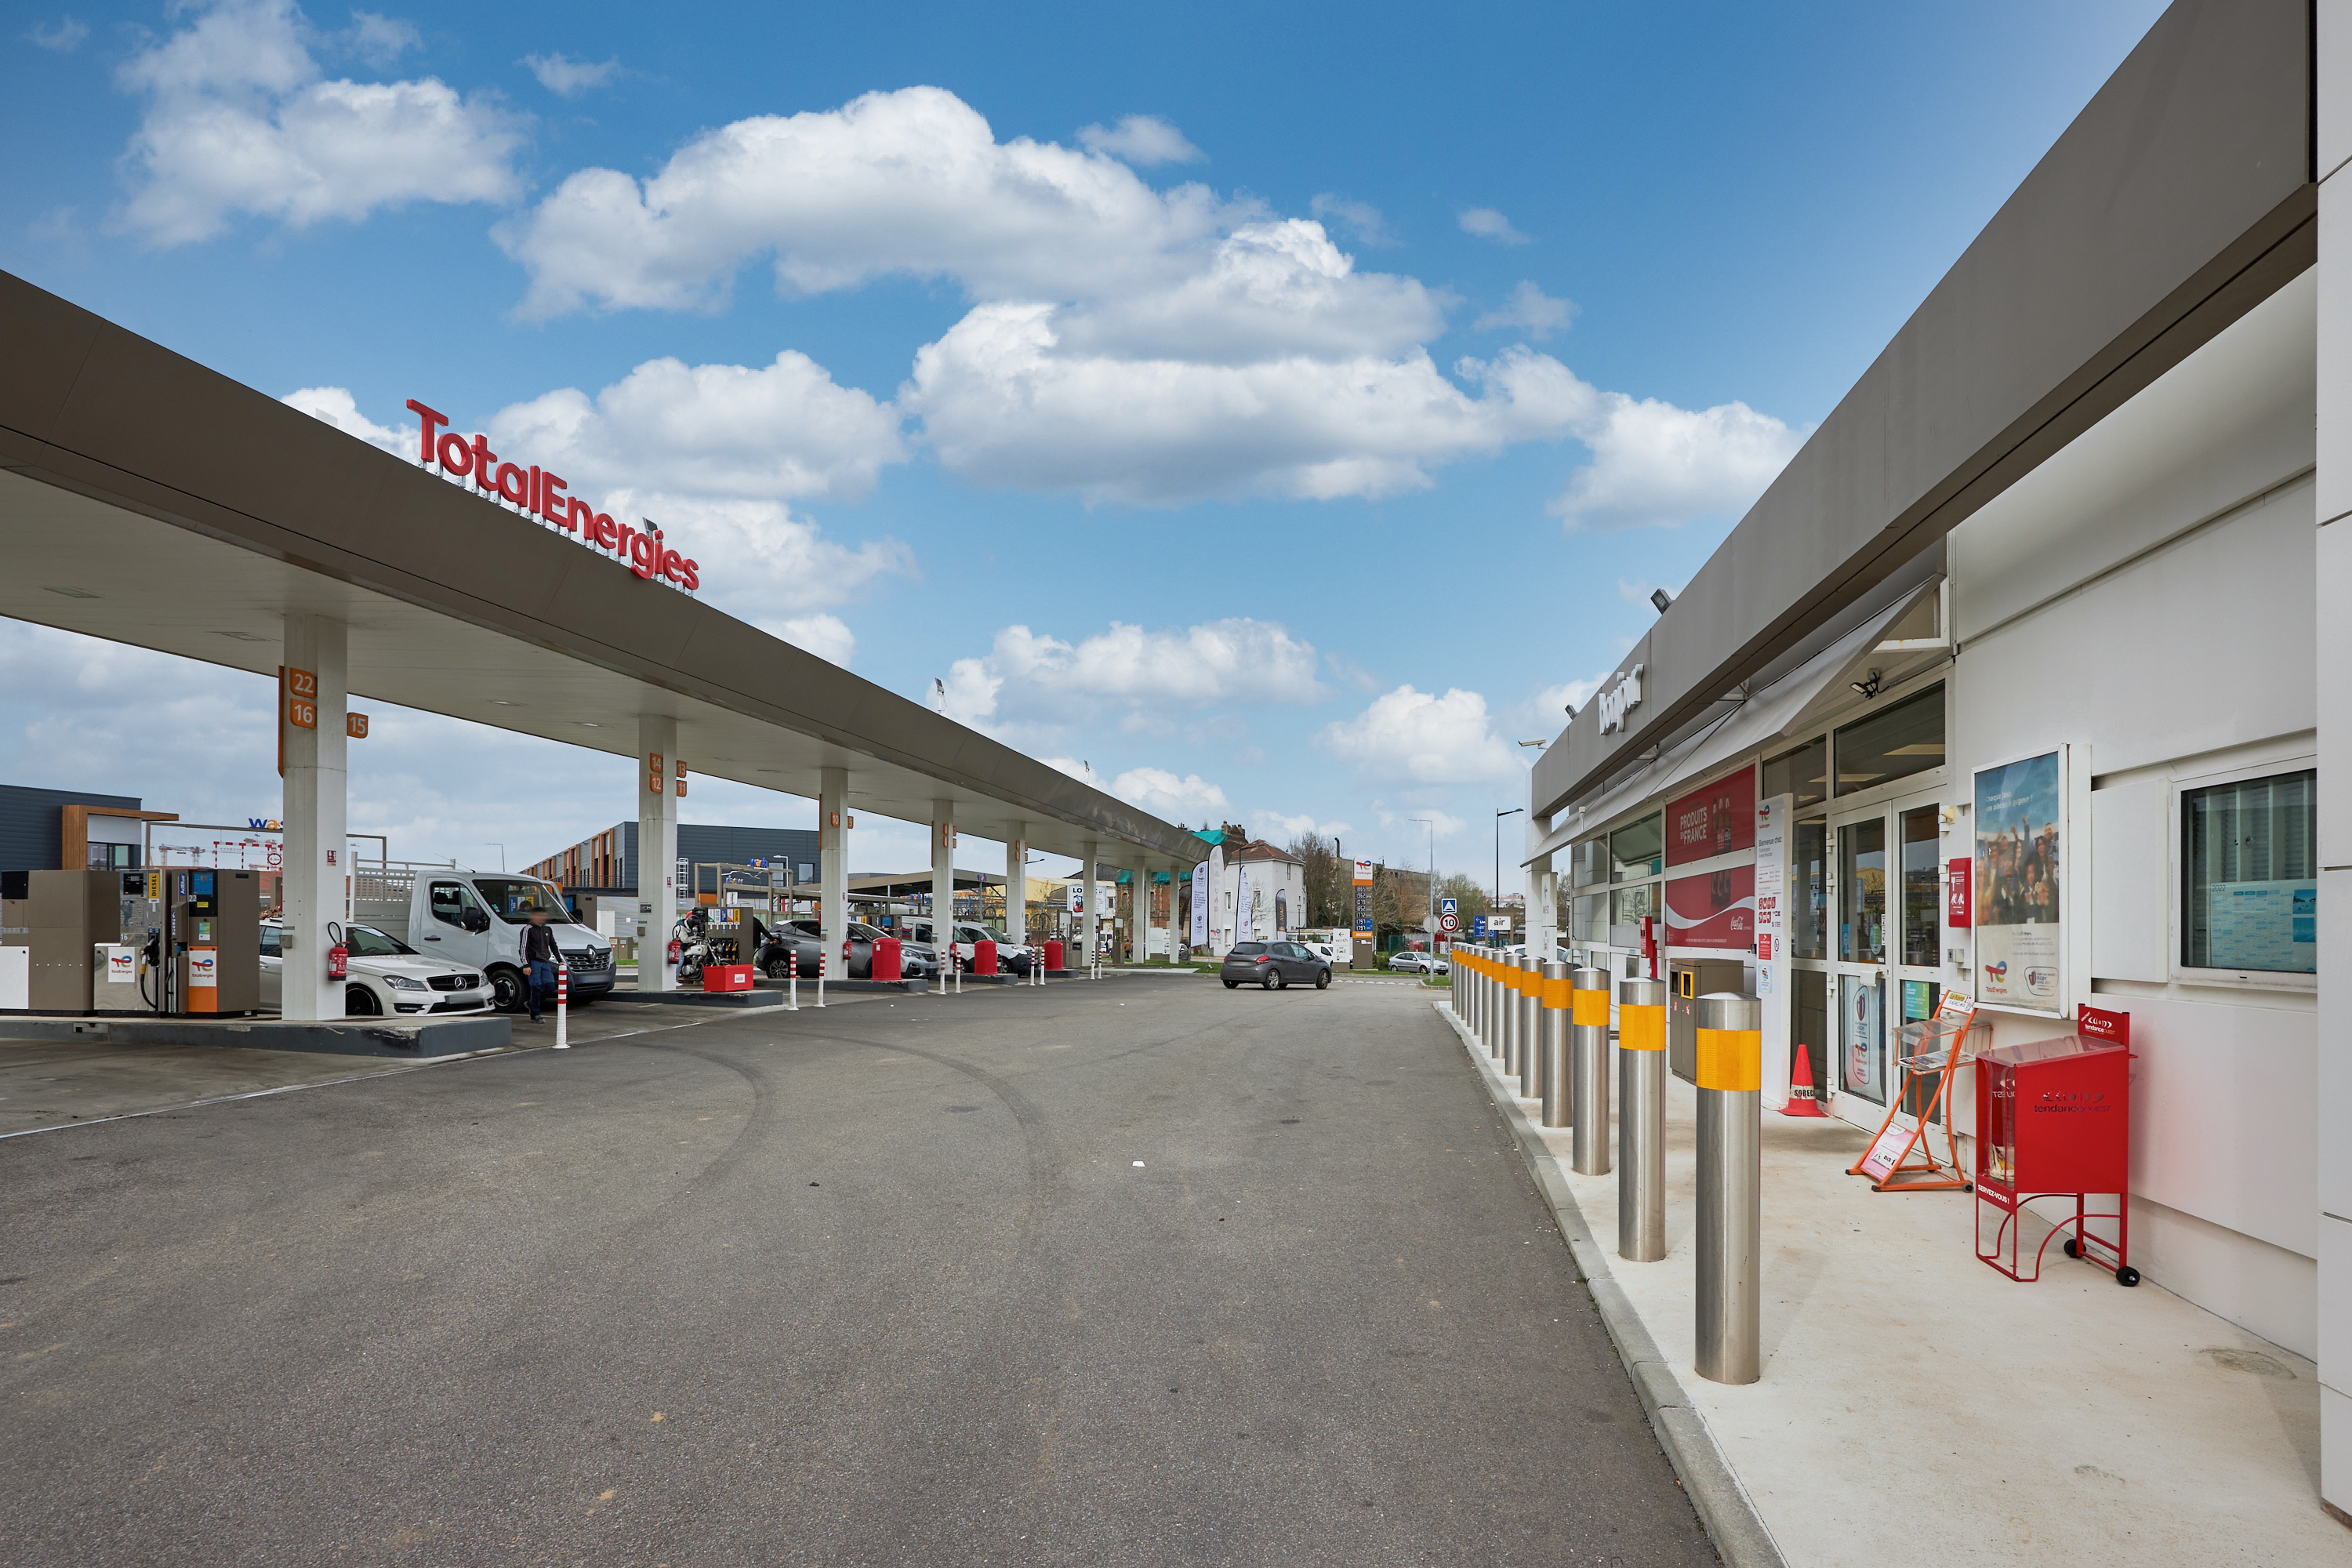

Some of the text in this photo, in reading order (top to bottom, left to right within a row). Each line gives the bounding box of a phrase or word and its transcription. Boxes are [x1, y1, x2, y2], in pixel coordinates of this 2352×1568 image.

[406, 399, 699, 590] TotalEnergies
[294, 673, 314, 694] 22
[1599, 664, 1644, 735] bonjour
[294, 704, 313, 724] 16
[350, 716, 366, 735] 15
[652, 757, 662, 769] 14
[677, 763, 686, 775] 13
[652, 777, 661, 789] 12
[678, 782, 686, 794] 11
[832, 815, 839, 825] 10
[1680, 806, 1707, 830] PRODUITS
[1683, 823, 1707, 845] FRANCE
